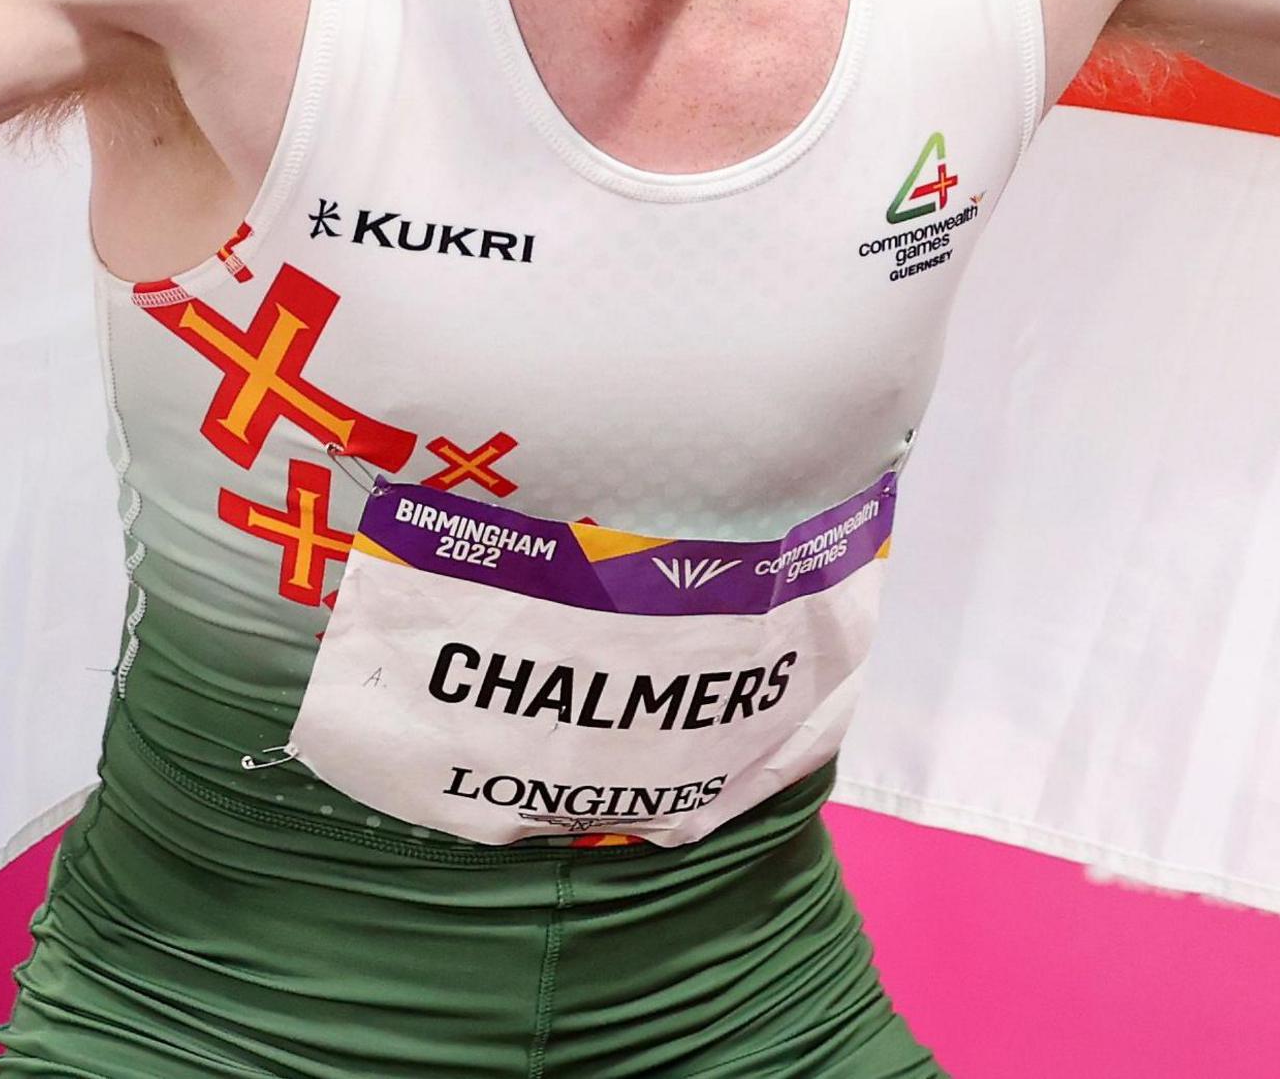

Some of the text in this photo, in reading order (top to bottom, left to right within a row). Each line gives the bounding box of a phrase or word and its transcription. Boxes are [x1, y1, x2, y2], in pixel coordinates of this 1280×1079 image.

[351, 209, 536, 263] KUKRI
[858, 205, 979, 257] commonwealth
[895, 233, 951, 266] games
[889, 249, 954, 282] GUERNSEY
[395, 498, 557, 561] BIRMINGHAM
[435, 536, 502, 568] 2022
[754, 499, 880, 576] commonwealth
[786, 538, 848, 583] games
[428, 642, 798, 731] CHALMERS
[443, 767, 729, 816] LONGINES
